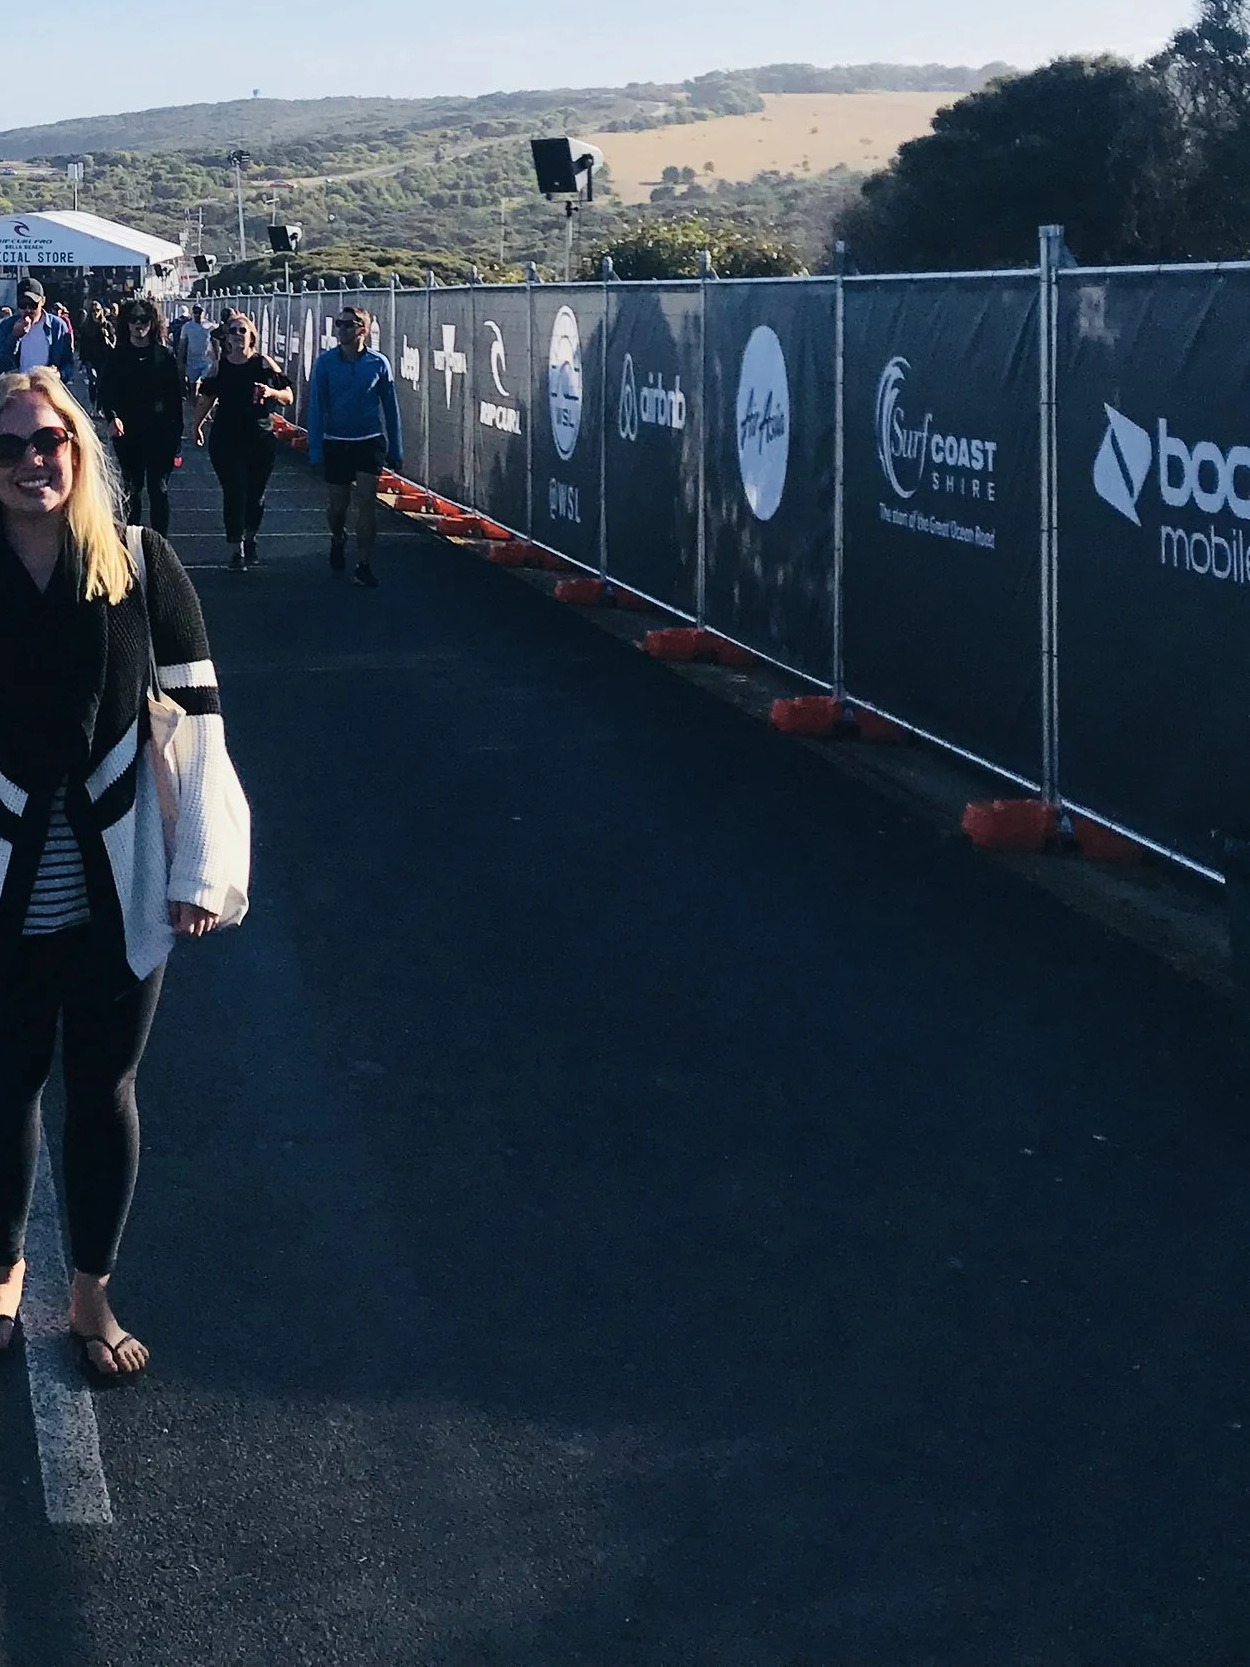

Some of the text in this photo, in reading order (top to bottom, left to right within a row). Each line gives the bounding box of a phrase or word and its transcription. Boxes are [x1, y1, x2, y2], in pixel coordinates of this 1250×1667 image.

[37, 251, 74, 263] STORE
[639, 372, 686, 430] airbnb
[891, 407, 998, 481] Surf COAST
[931, 471, 997, 502] SHIRE
